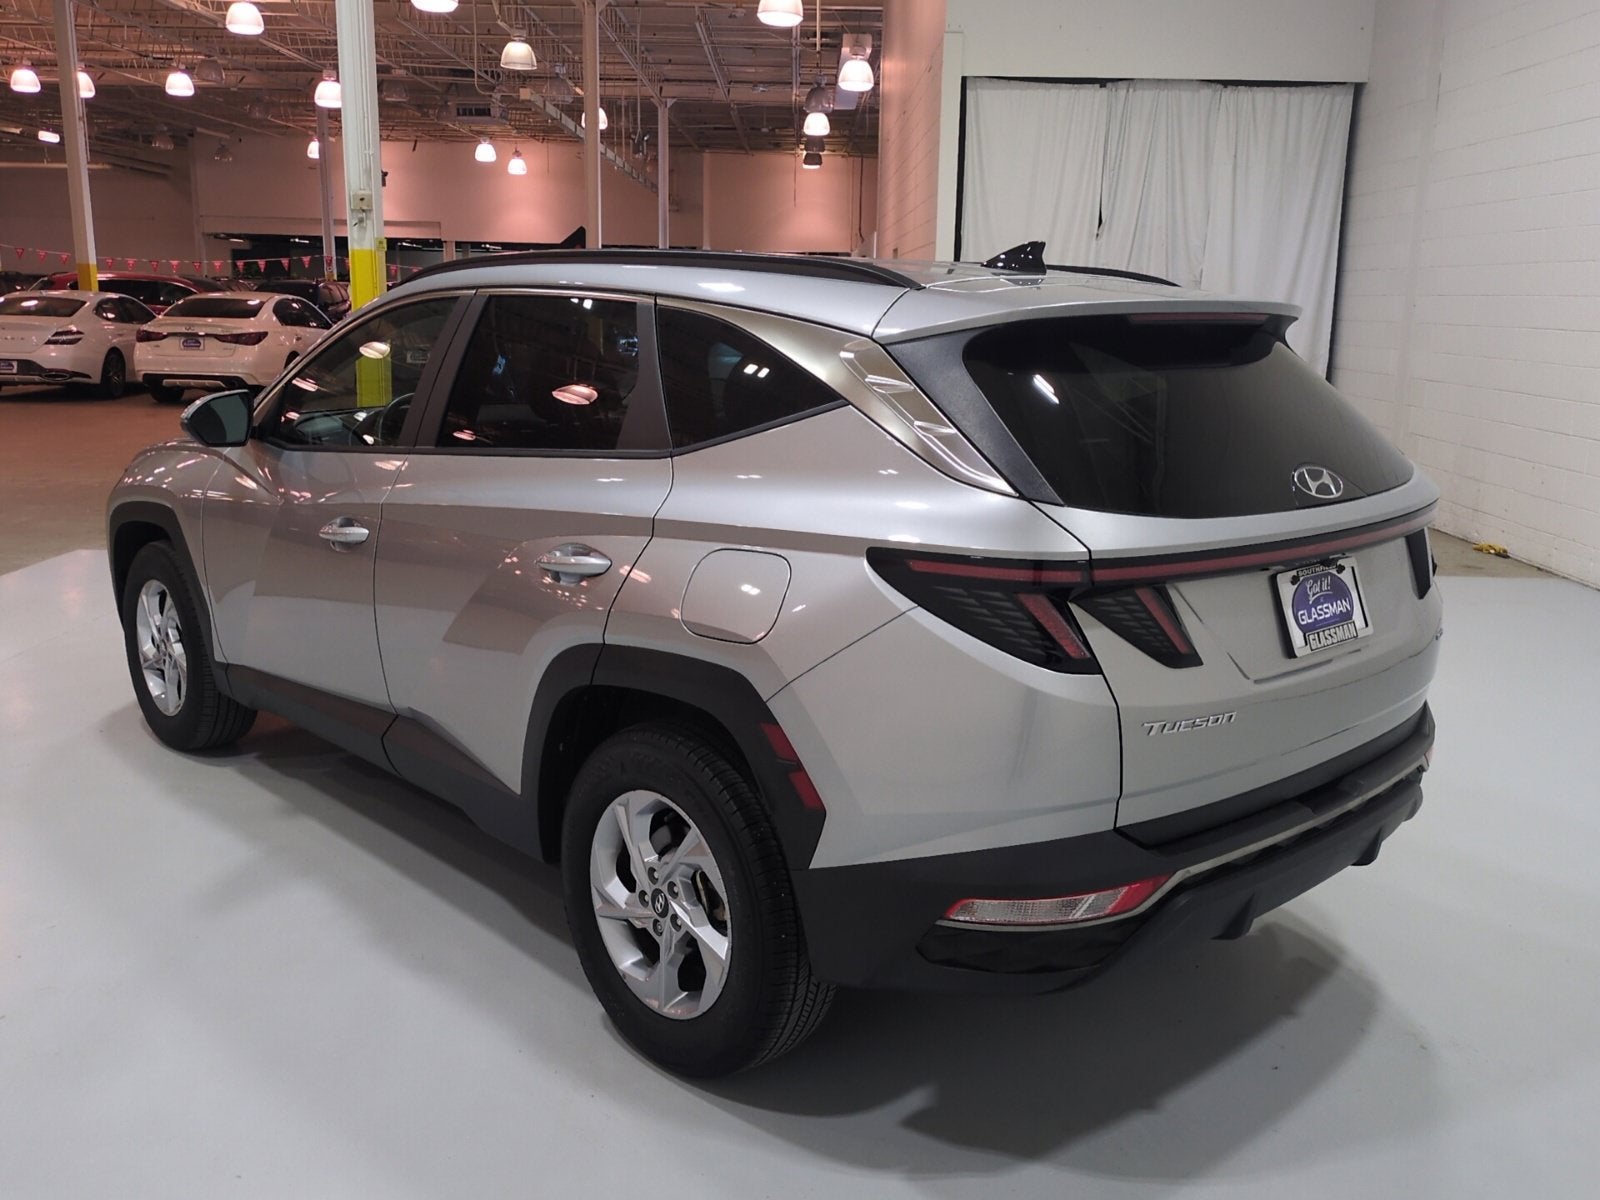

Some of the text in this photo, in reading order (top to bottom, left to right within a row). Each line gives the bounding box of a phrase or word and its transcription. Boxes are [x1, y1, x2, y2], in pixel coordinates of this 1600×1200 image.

[1298, 565, 1336, 577] SOUTHFI
[1306, 576, 1332, 597] Got it!
[1298, 598, 1351, 625] GLASSMAN
[1309, 623, 1357, 649] GLASSMAN
